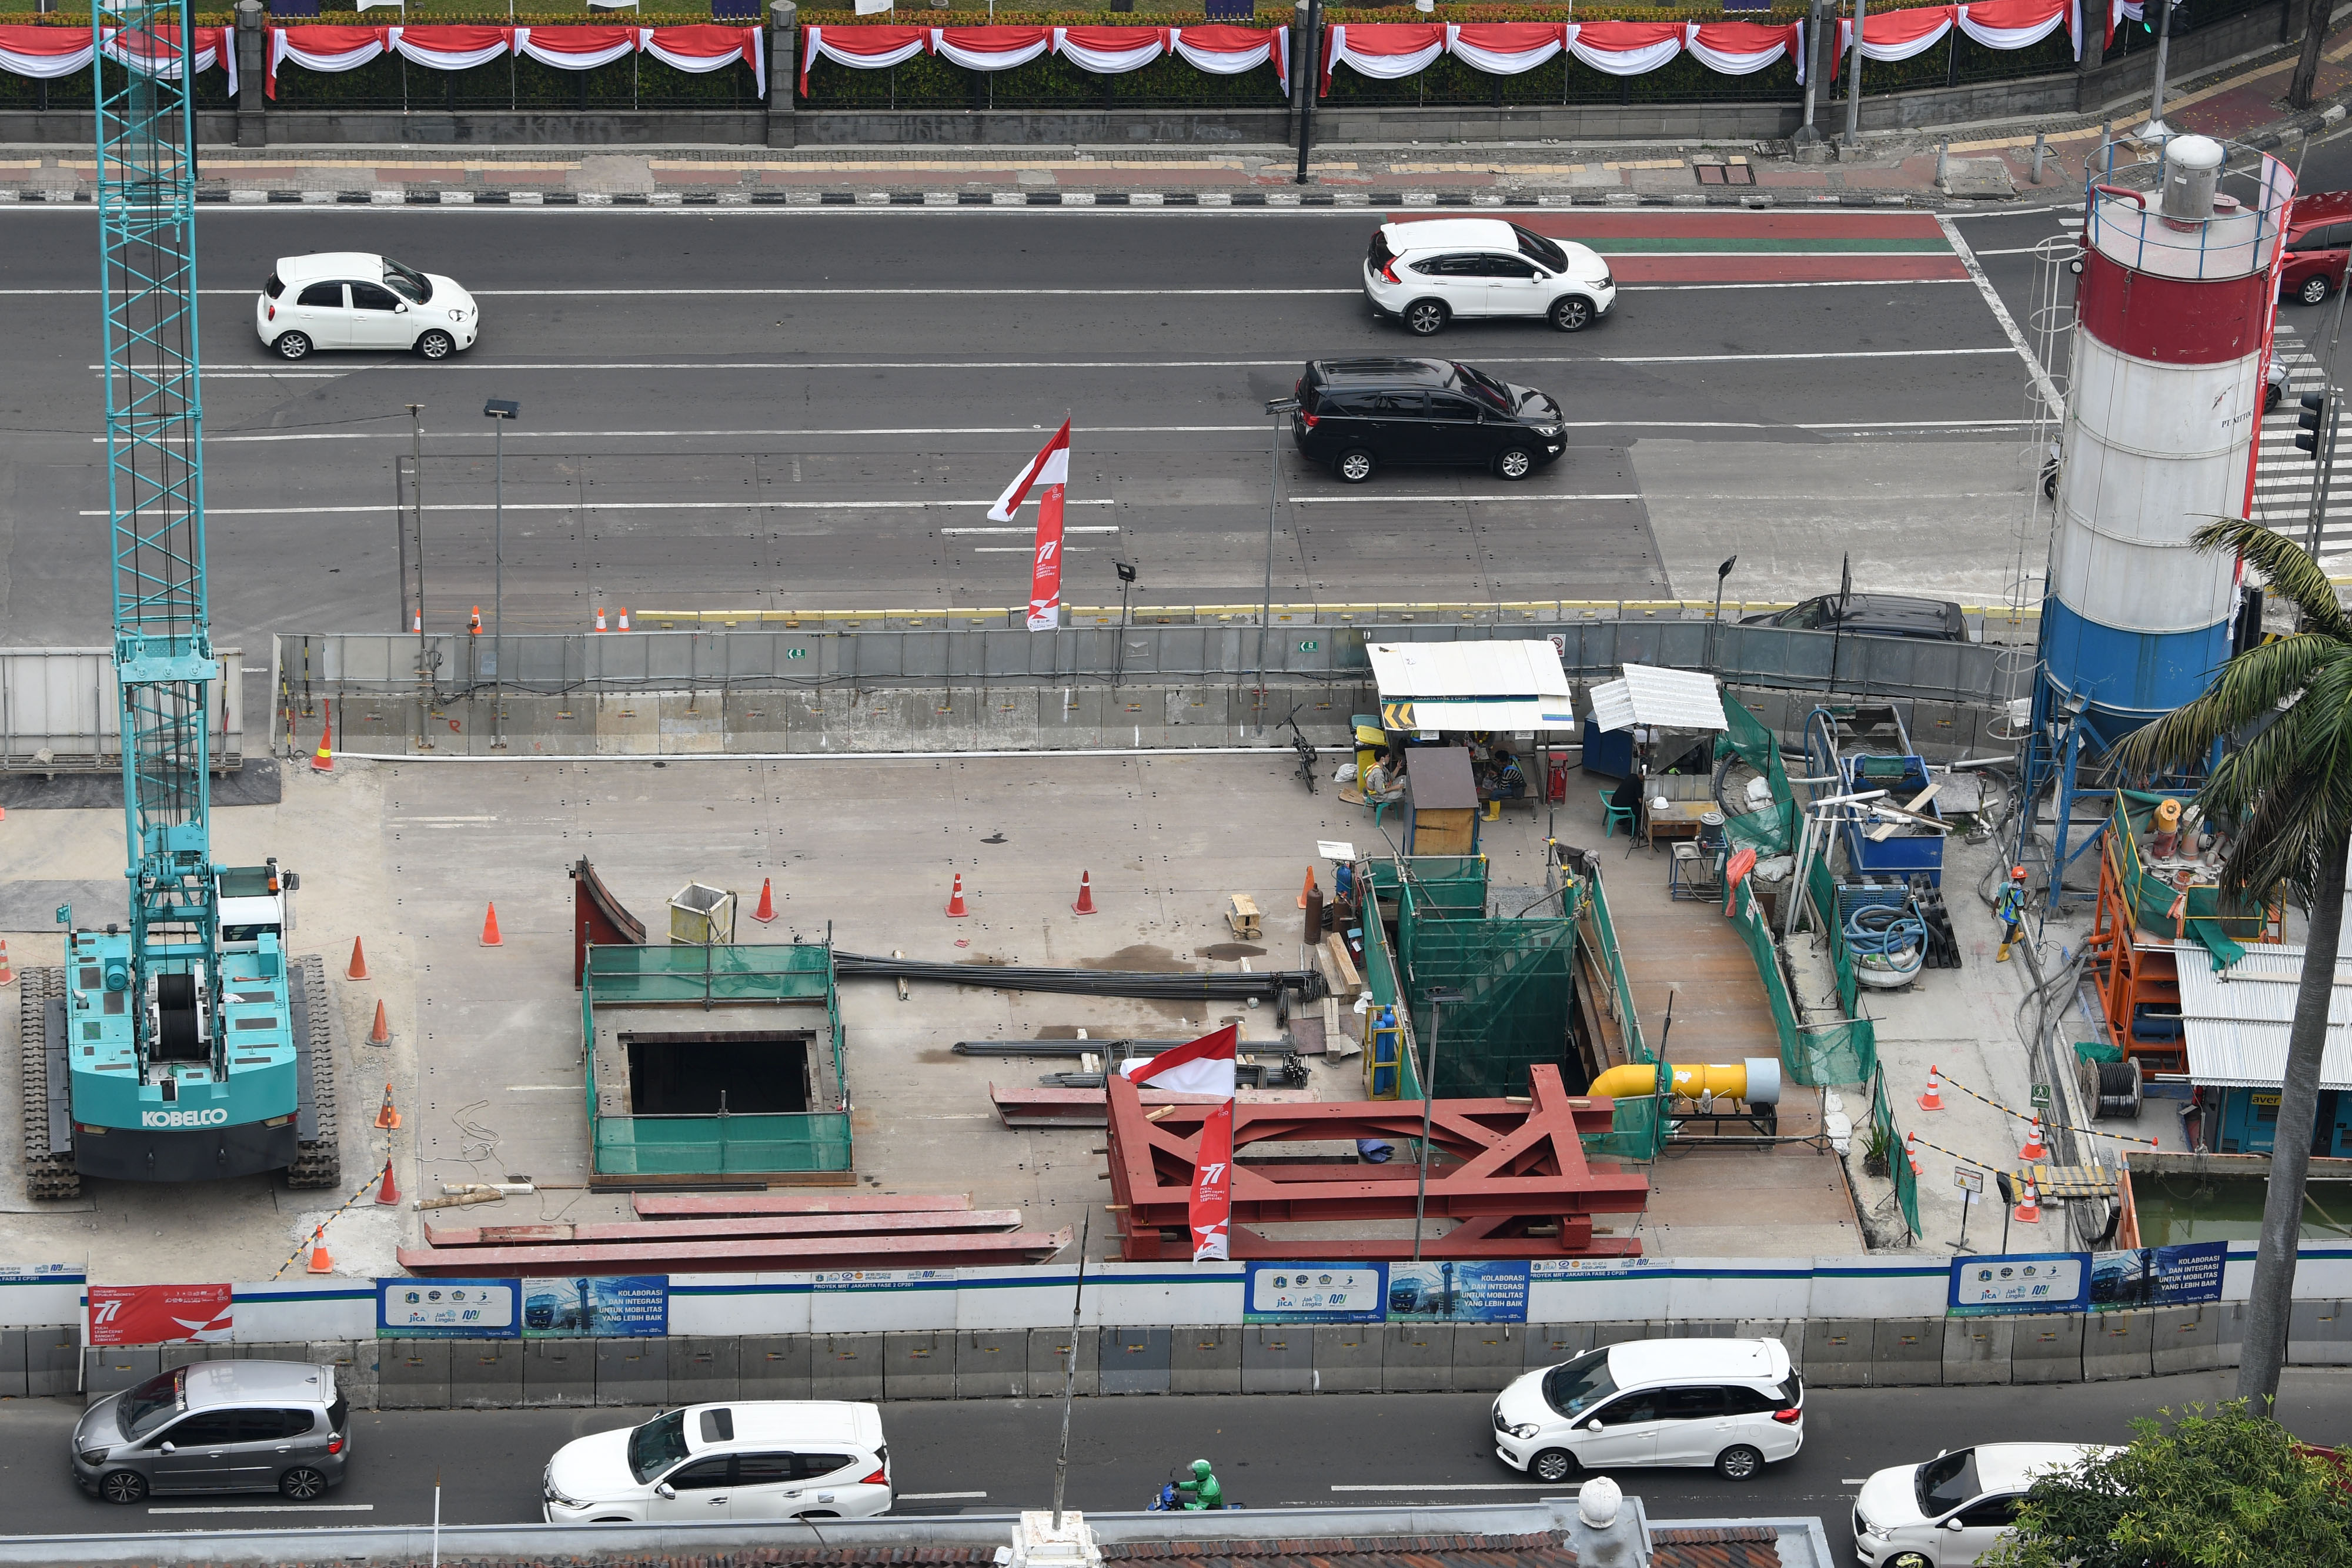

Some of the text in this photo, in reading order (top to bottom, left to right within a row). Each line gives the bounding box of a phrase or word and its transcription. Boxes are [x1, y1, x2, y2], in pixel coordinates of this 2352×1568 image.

[2221, 419, 2231, 428] PT
[1037, 540, 1058, 564] 77
[2252, 1096, 2279, 1104] aver
[142, 1108, 228, 1127] KOBELCO
[1200, 1163, 1227, 1186] 77
[2178, 1255, 2220, 1265] KOLABORASI
[2184, 1263, 2219, 1273] INTEGRASI
[2183, 1272, 2217, 1281] MOBILITAS
[94, 1300, 122, 1324] 77
